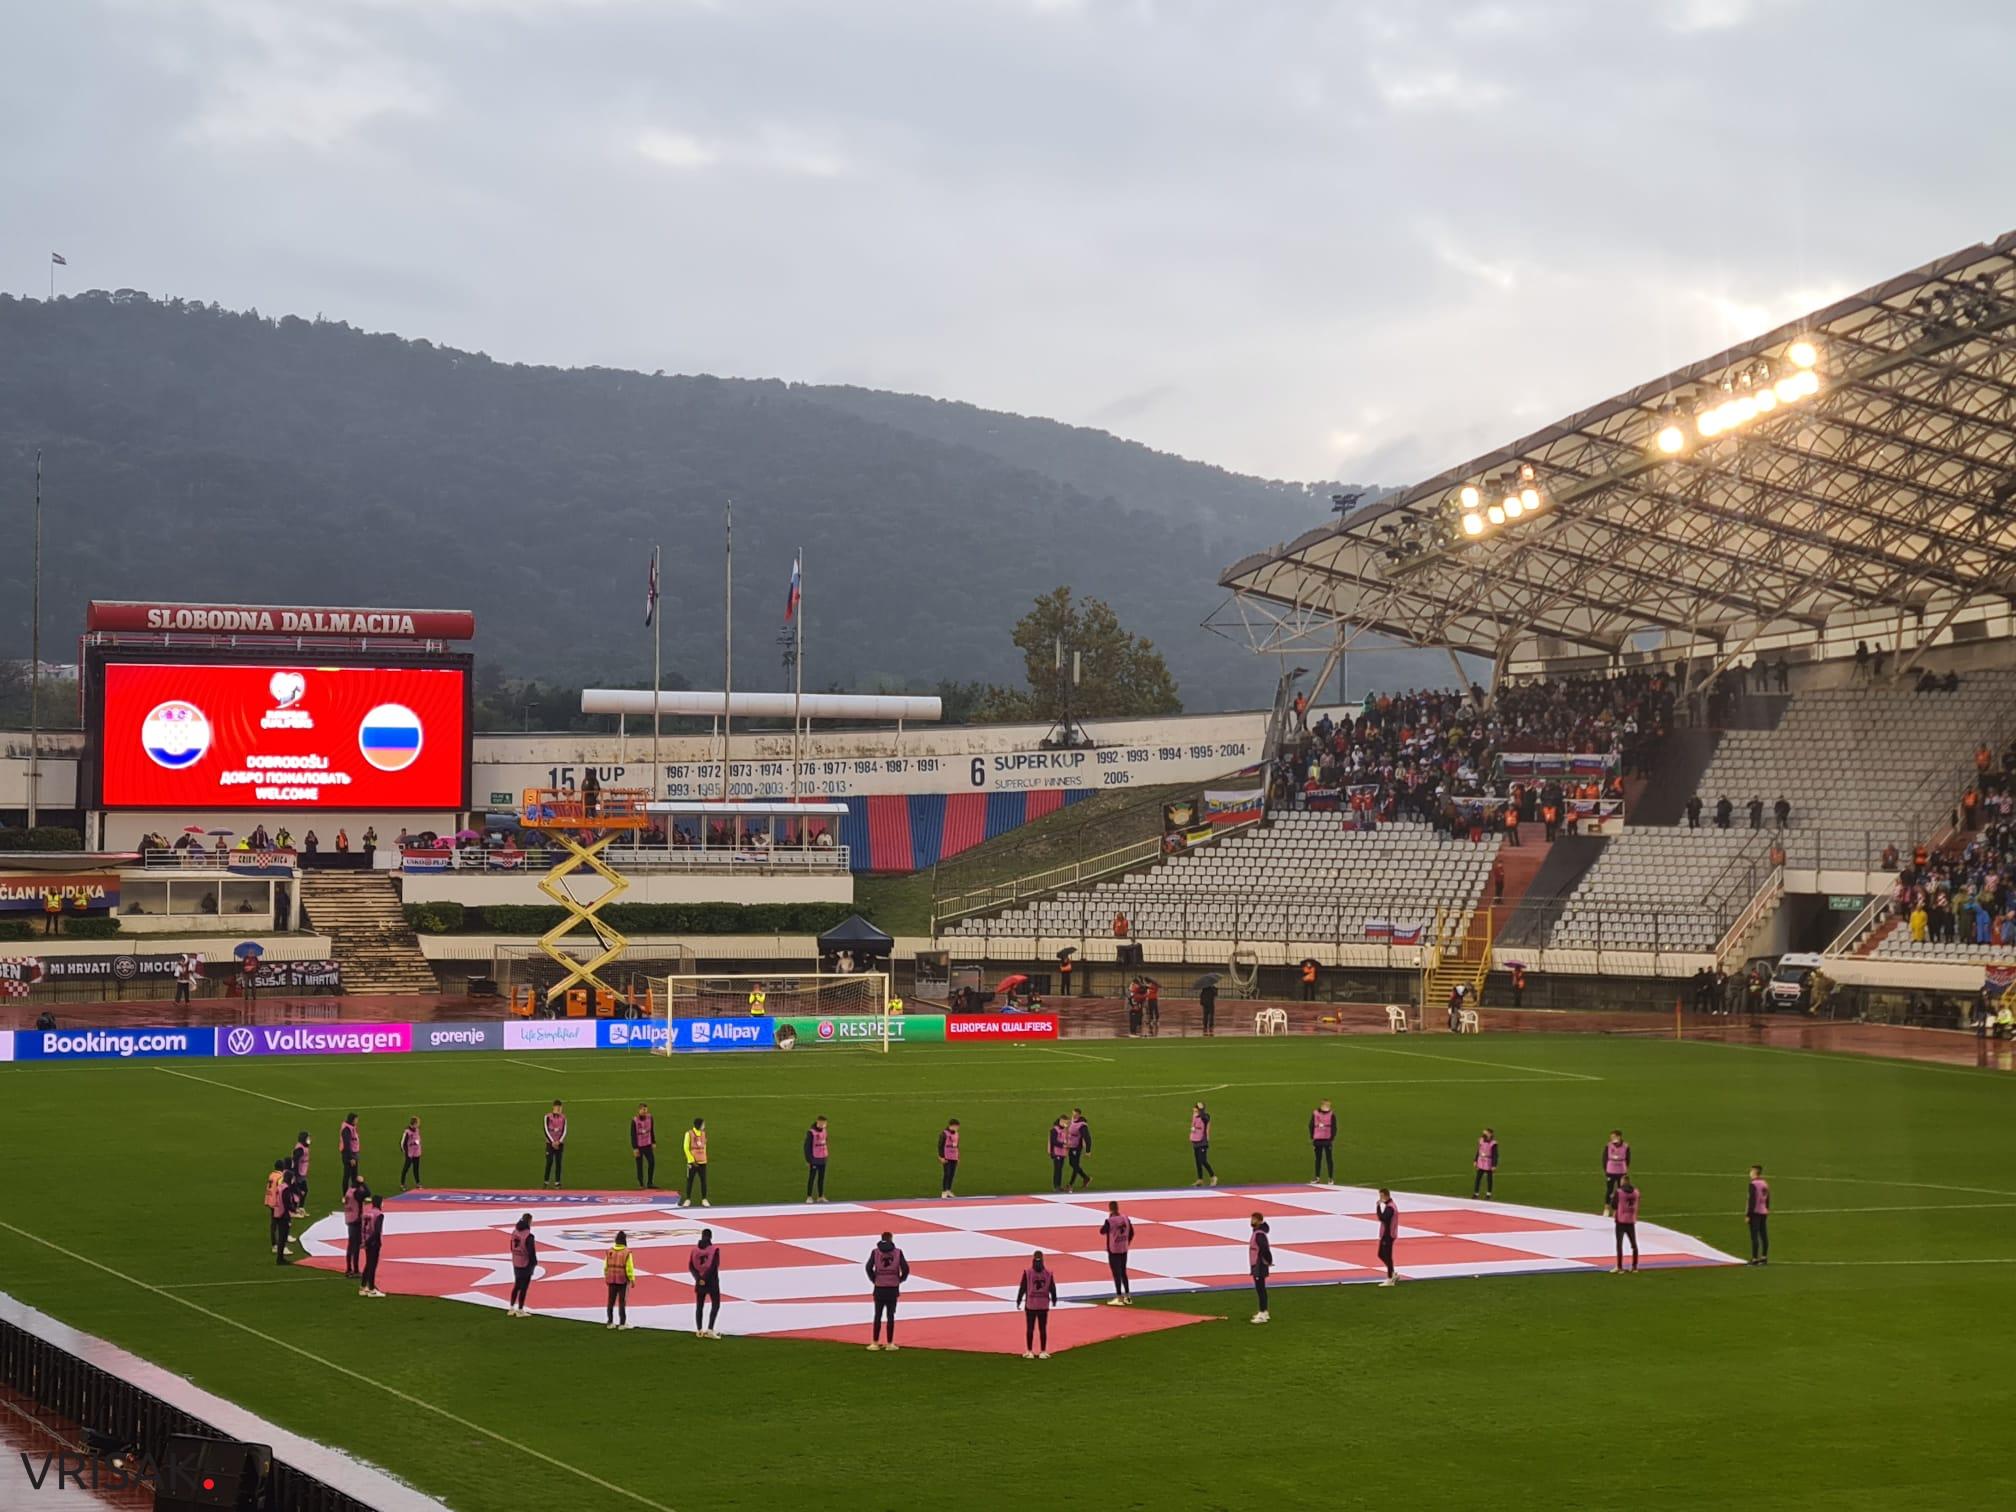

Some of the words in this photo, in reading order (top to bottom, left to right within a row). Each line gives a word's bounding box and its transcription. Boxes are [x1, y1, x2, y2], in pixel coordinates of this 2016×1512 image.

[147, 609, 274, 631] SLOBODNA
[281, 612, 415, 634] DALMACIJA
[246, 754, 329, 769] DOBRODOŠLI
[1096, 751, 1118, 764] 1992
[1127, 749, 1149, 762] 1993
[1159, 747, 1181, 760] 1994
[1190, 746, 1213, 759] 1995
[1220, 743, 1245, 757] 2004
[666, 766, 689, 778] 1967
[698, 765, 721, 778] 1972
[729, 764, 752, 777] 1973
[760, 763, 783, 776] 1974
[823, 761, 846, 775] 1977
[854, 761, 877, 773] 1984
[885, 760, 908, 773] 1987
[917, 759, 939, 772] 1991
[970, 757, 986, 786] 6
[994, 755, 1048, 771] SUPER
[1050, 753, 1085, 768] KUP
[548, 767, 575, 797] 15
[994, 778, 1041, 789] SUPERCUP
[1044, 776, 1082, 787] WINNERS
[1104, 771, 1129, 784] 2005
[255, 787, 319, 800] WELCOME
[667, 783, 689, 796] 1993
[697, 783, 720, 796] 1995
[728, 782, 753, 795] 2000
[760, 782, 783, 795] 2003
[822, 780, 846, 793] 2013
[0, 883, 36, 900] ČLAN
[39, 884, 105, 899] HJDUKA
[50, 963, 65, 975] MI
[67, 962, 111, 974] HRVATI
[306, 972, 339, 986] MARTIN
[630, 1023, 679, 1042] Alipay
[712, 1023, 760, 1041] Alipay
[839, 1022, 905, 1036] RESPECT
[950, 1022, 1000, 1033] EUROPEAN
[1001, 1022, 1053, 1033] QUALIFIERS
[43, 1032, 187, 1056] Booking.com
[264, 1030, 401, 1053] Volkswagen
[430, 1028, 485, 1045] gorenje
